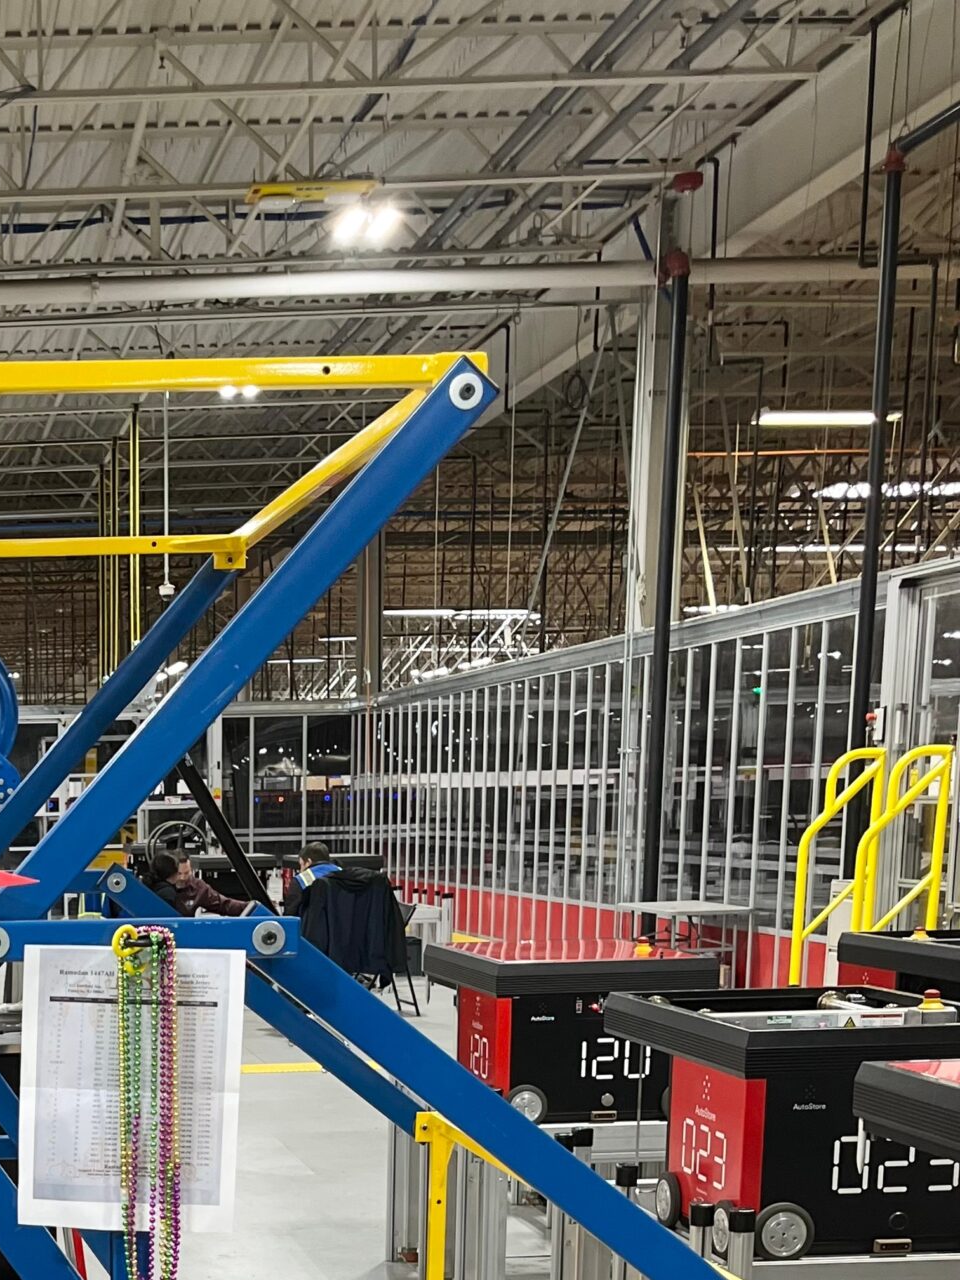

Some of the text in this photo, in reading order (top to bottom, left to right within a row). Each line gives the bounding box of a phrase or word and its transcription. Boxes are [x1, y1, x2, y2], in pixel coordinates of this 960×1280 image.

[469, 1033, 489, 1079] 120
[580, 1037, 652, 1080] 120
[792, 1103, 827, 1112] AutoStore
[681, 1117, 727, 1191] 023
